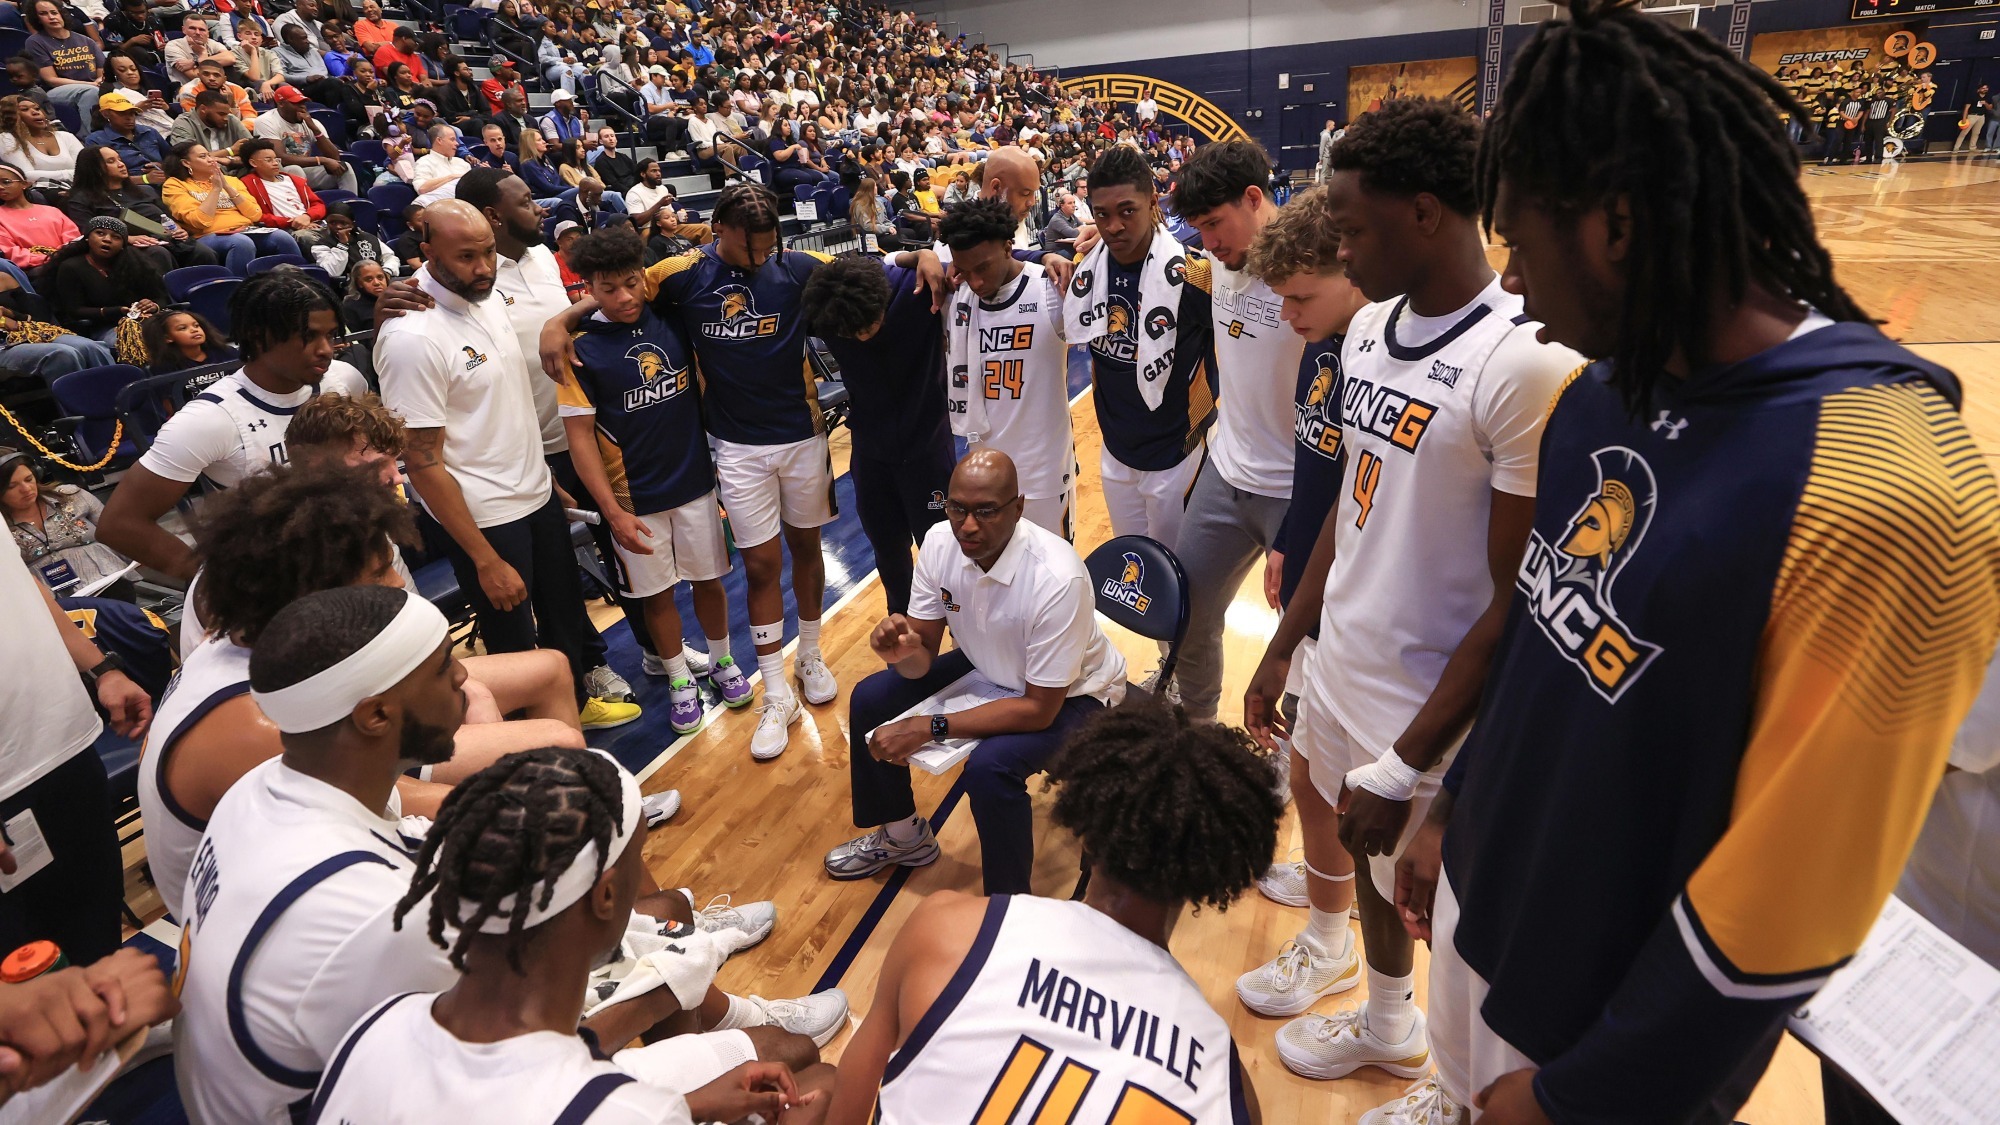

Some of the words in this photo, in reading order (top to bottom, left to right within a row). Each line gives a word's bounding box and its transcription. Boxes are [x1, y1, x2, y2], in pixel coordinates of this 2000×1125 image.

[52, 45, 90, 56] UNCG
[53, 53, 96, 66] Spartans
[1779, 48, 1870, 64] SPARTANS
[703, 315, 779, 338] UNCG
[1213, 284, 1283, 328] JUICE
[625, 368, 689, 411] UNCG
[984, 359, 1024, 400] 24
[1427, 359, 1463, 389] SOCON
[1343, 376, 1440, 455] UNCG
[1353, 449, 1383, 531] 4
[1102, 580, 1150, 613] UNCG
[1517, 538, 1643, 692] UNCG
[1017, 957, 1204, 1094] MARVILLE
